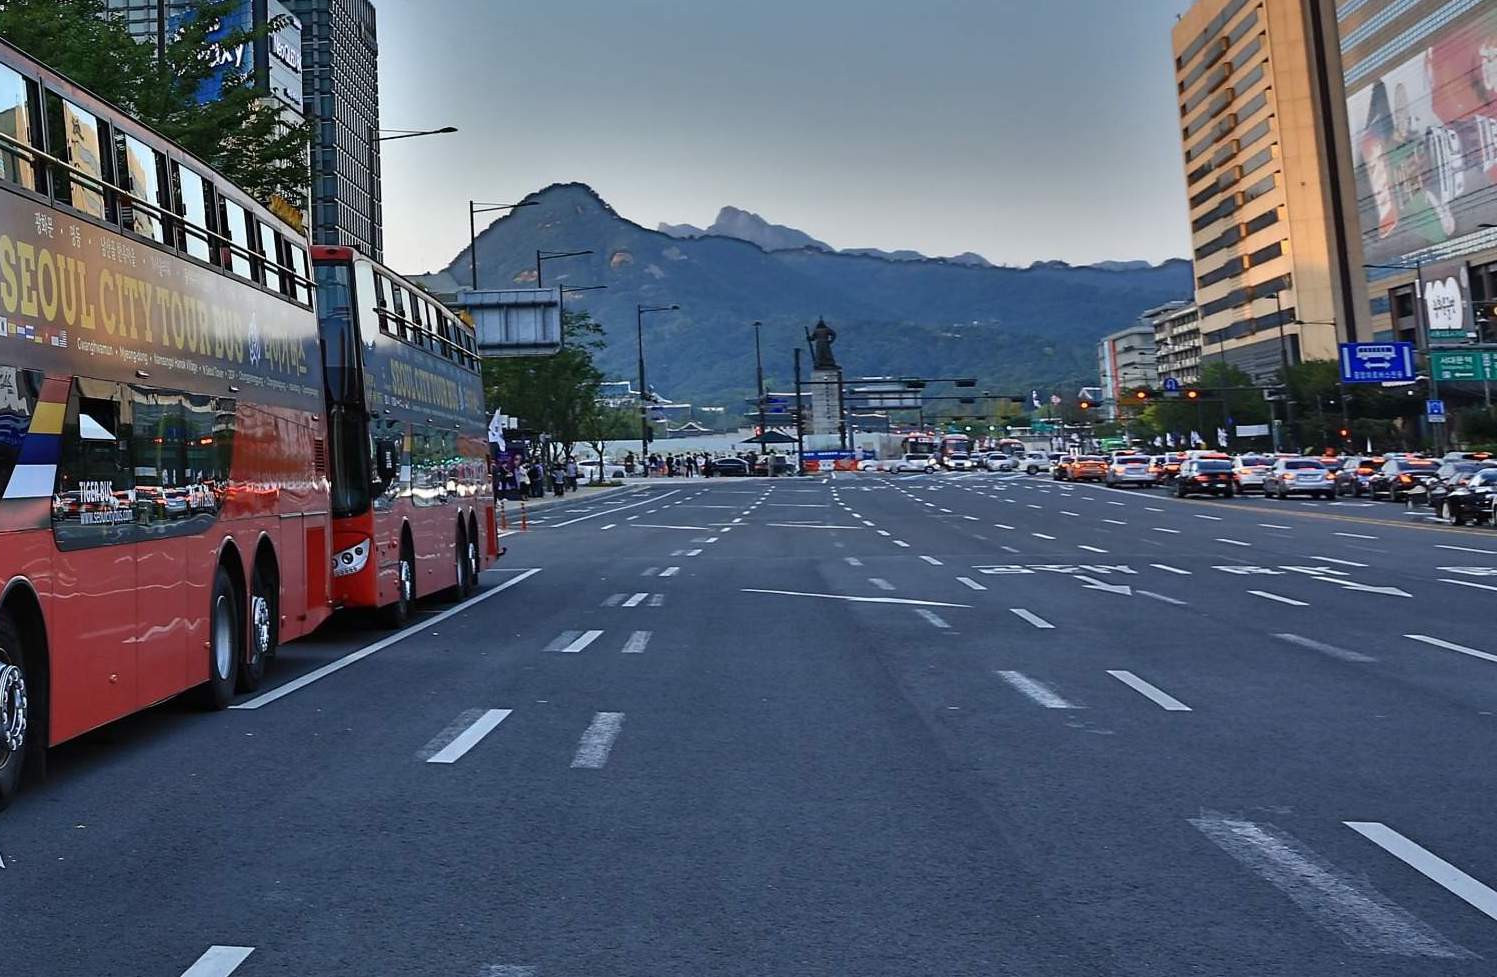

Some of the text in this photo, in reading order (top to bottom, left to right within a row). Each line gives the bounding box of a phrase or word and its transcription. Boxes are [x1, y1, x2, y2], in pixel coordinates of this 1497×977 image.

[98, 268, 153, 343] CITY
[155, 286, 212, 357] TOUR
[212, 304, 244, 364] BUS
[78, 480, 99, 502] TIGER
